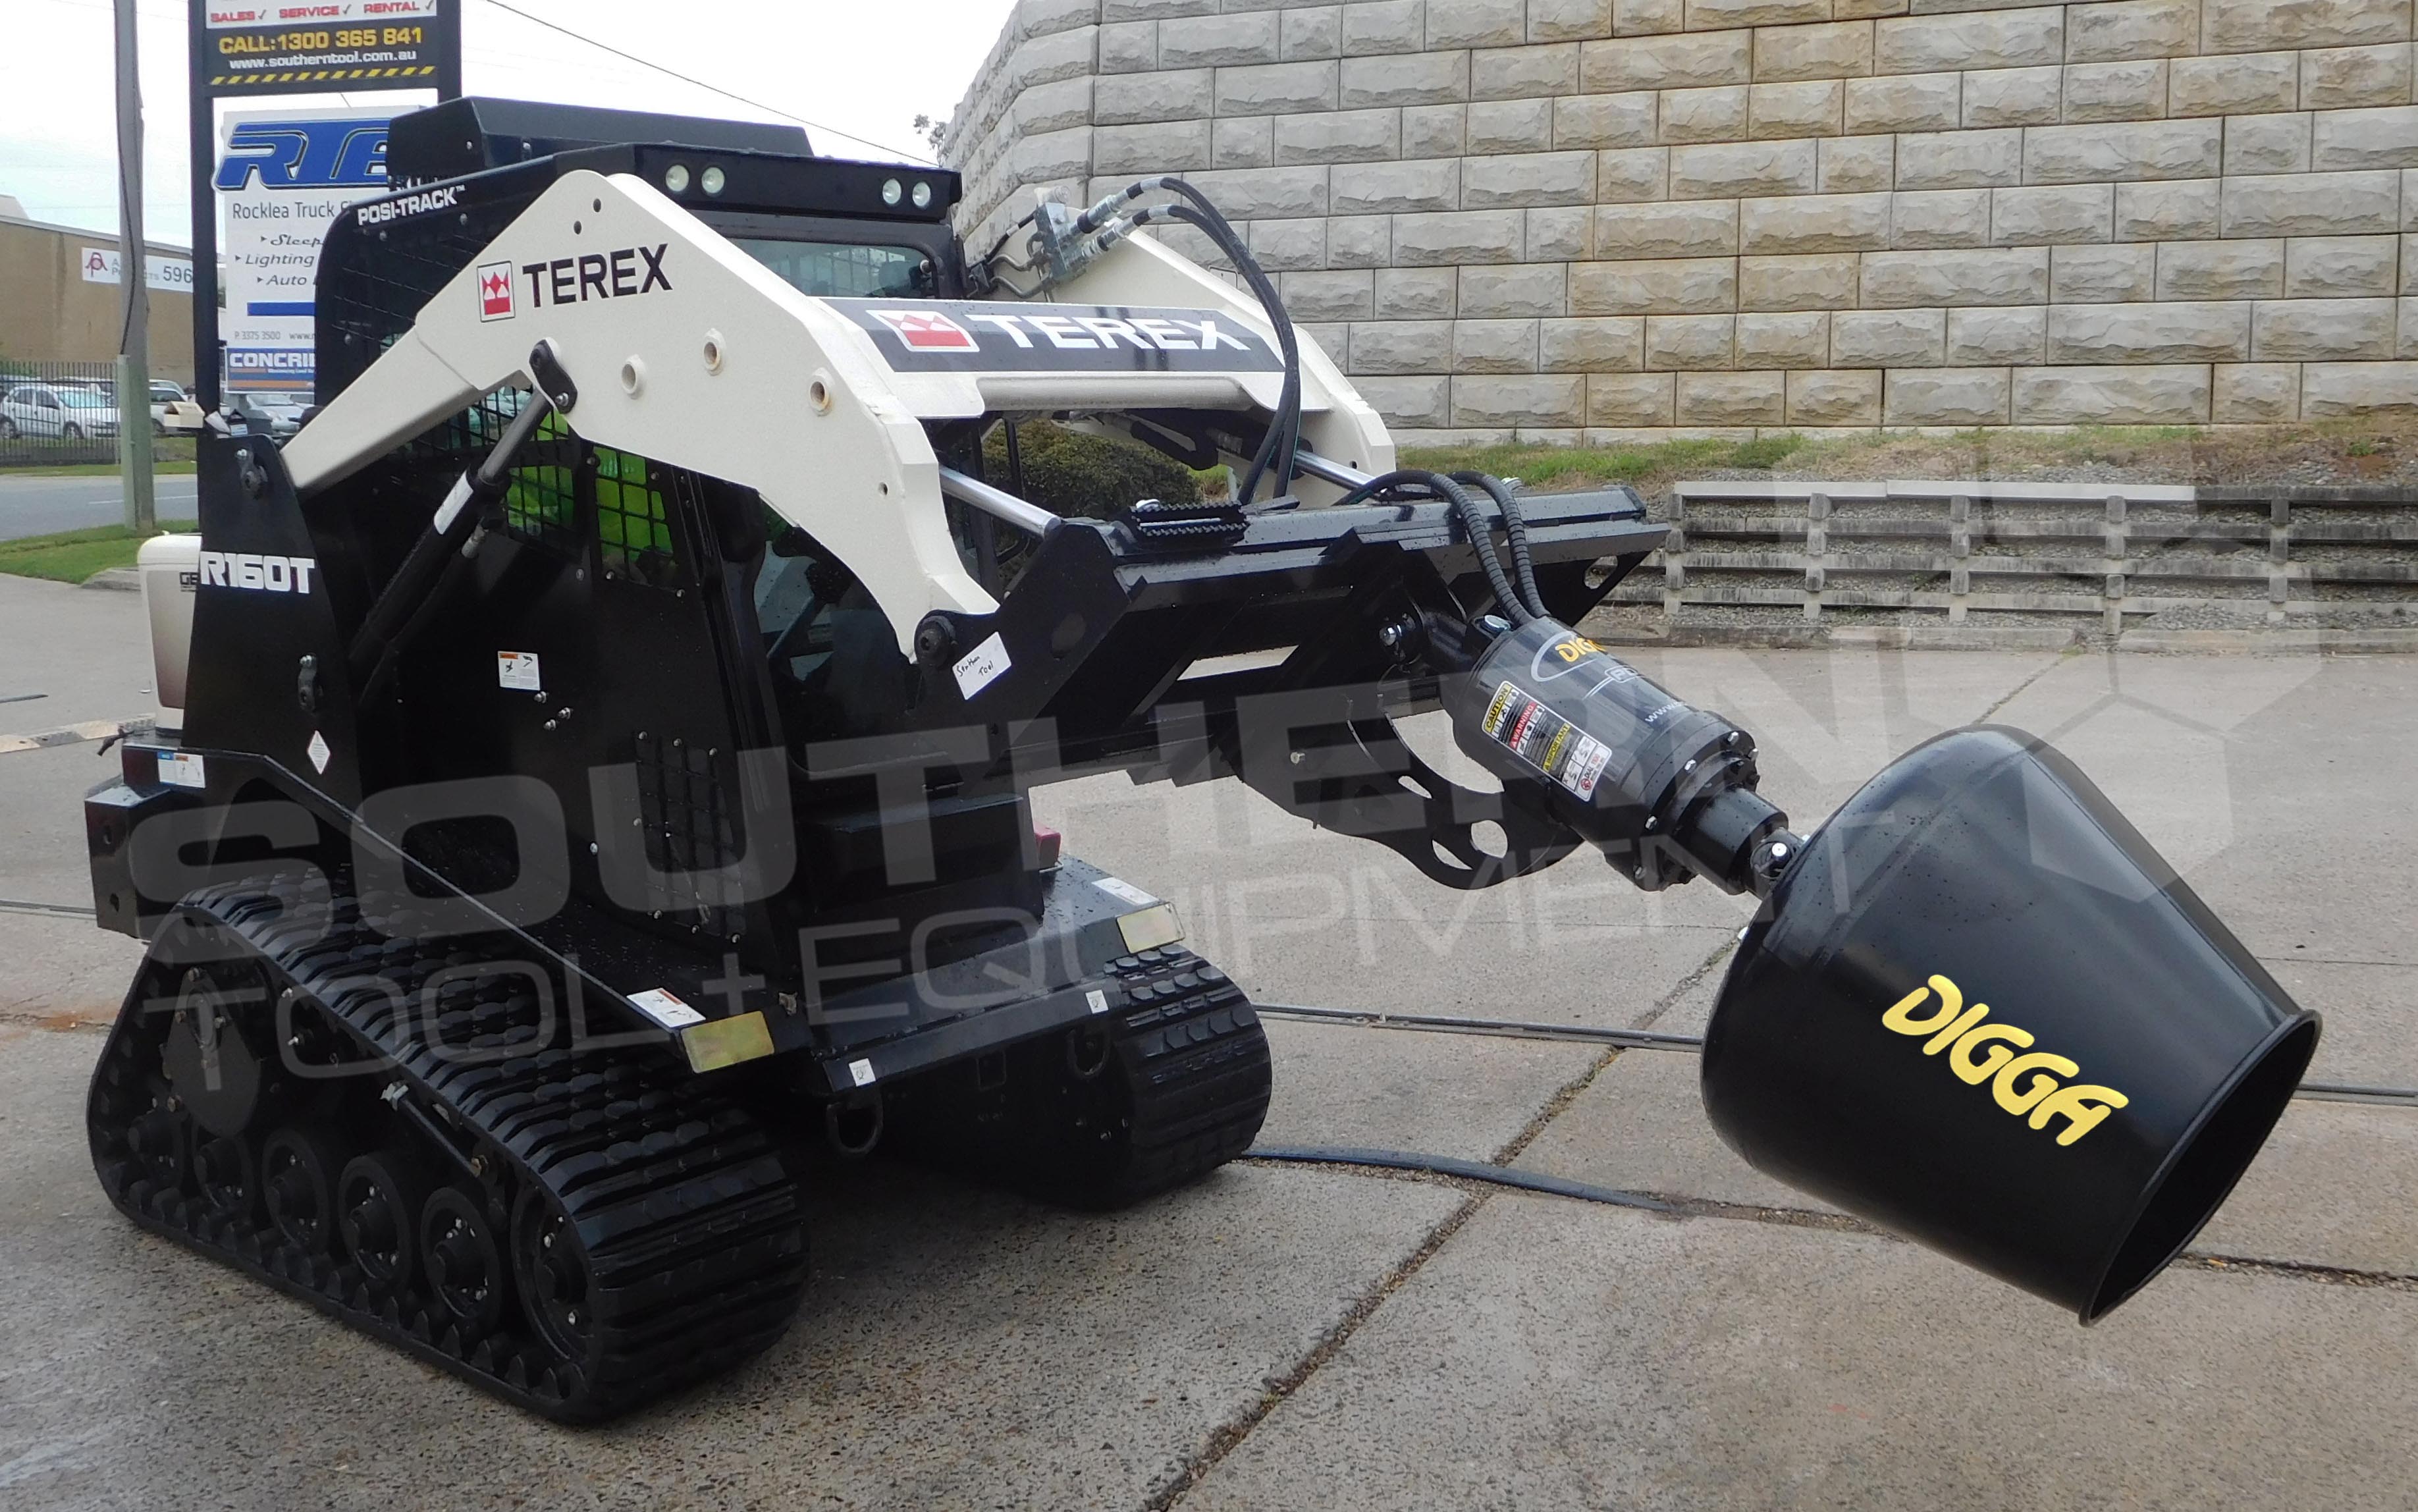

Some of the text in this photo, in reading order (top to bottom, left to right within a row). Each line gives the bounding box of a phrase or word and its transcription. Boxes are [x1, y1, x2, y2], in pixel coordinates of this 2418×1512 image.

[210, 11, 255, 22] SALES
[279, 5, 340, 19] SERVICE
[363, 1, 420, 14] RENTAL
[335, 29, 377, 48] 365
[383, 27, 422, 45] 841
[230, 50, 417, 69] www.southerntool.com.au
[232, 202, 289, 219] Rocklea
[294, 200, 335, 218] Truck
[270, 233, 323, 248] Sleep
[245, 253, 315, 268] Lighting
[163, 266, 193, 283] 596
[266, 275, 308, 285] Auto
[522, 244, 673, 308] TEREX
[965, 313, 1251, 350] TEREX
[200, 551, 315, 594] R160T
[1486, 688, 1509, 728] CAUTION
[1513, 705, 1534, 740] WARNING
[1547, 725, 1569, 762] IMPORTANT
[1882, 974, 2129, 1147] DIGGA
